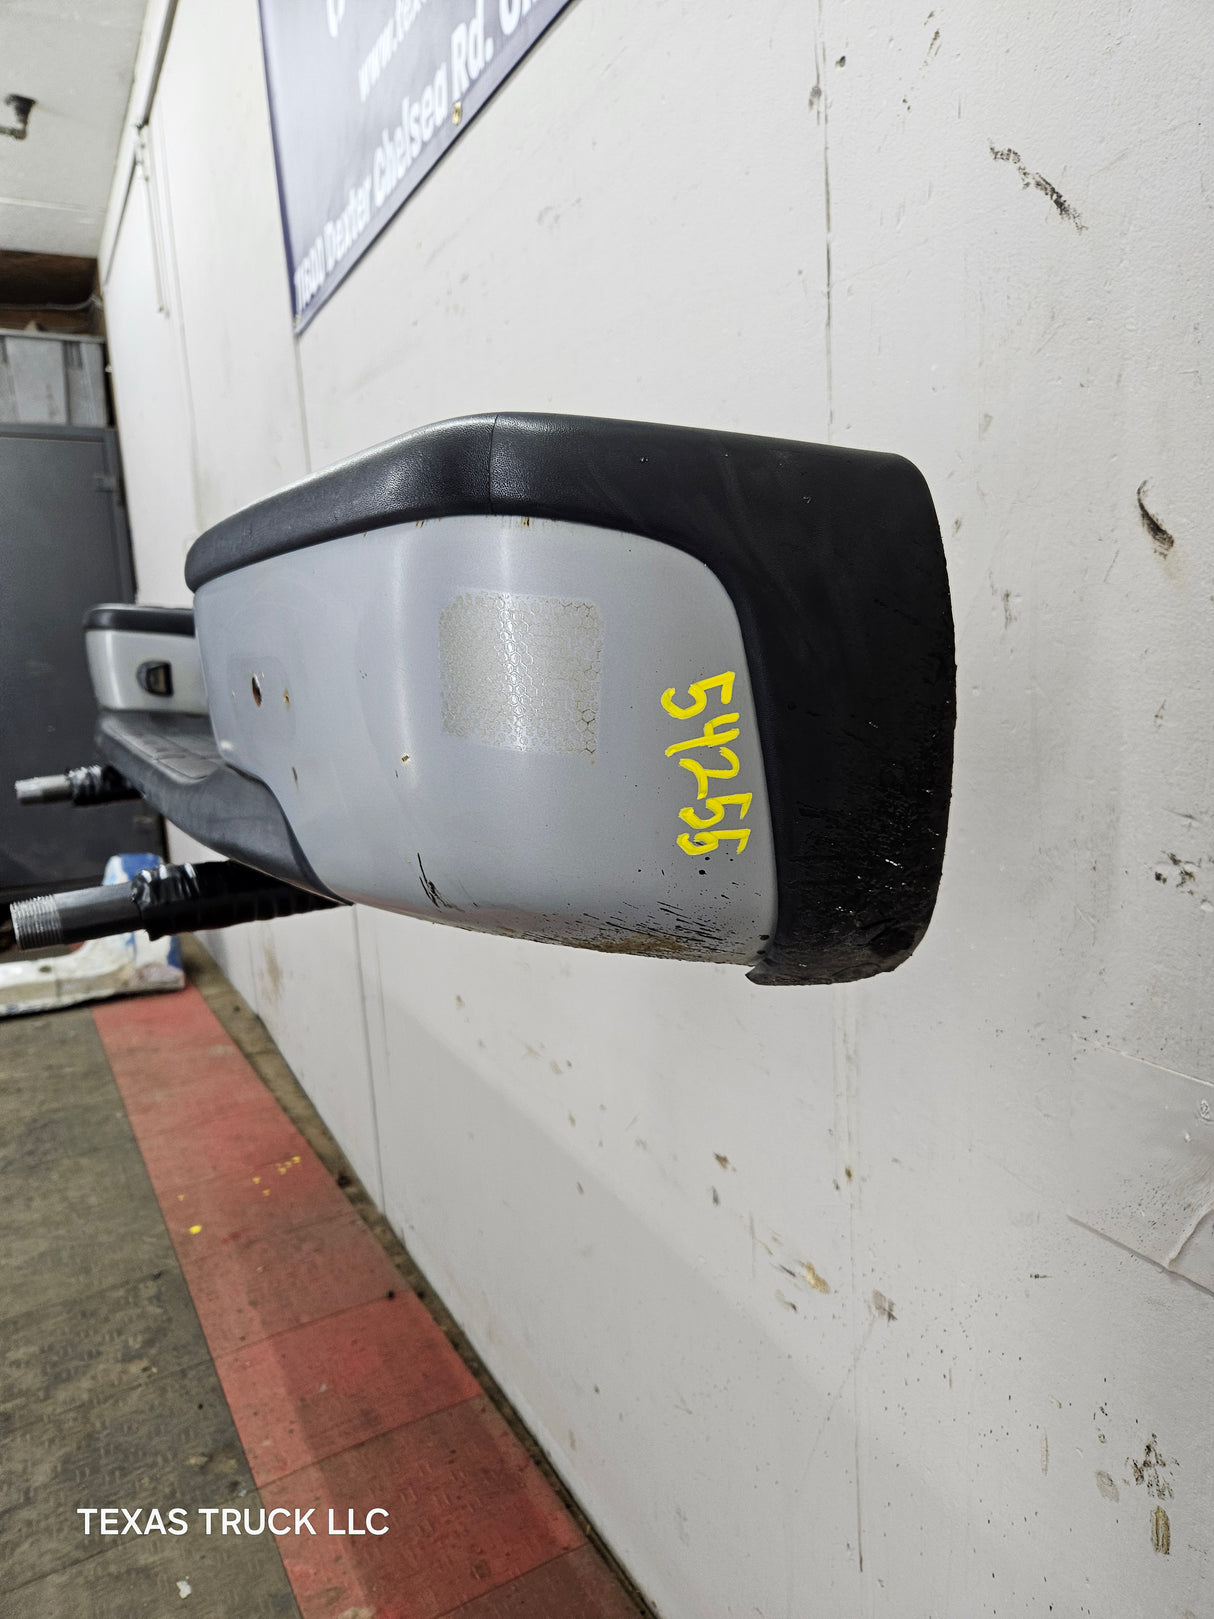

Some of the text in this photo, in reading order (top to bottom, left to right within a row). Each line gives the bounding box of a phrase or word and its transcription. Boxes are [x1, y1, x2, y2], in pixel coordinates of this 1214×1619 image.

[323, 174, 372, 272] Dexter
[373, 62, 449, 208] Chelsea
[451, 0, 494, 100] Rd.
